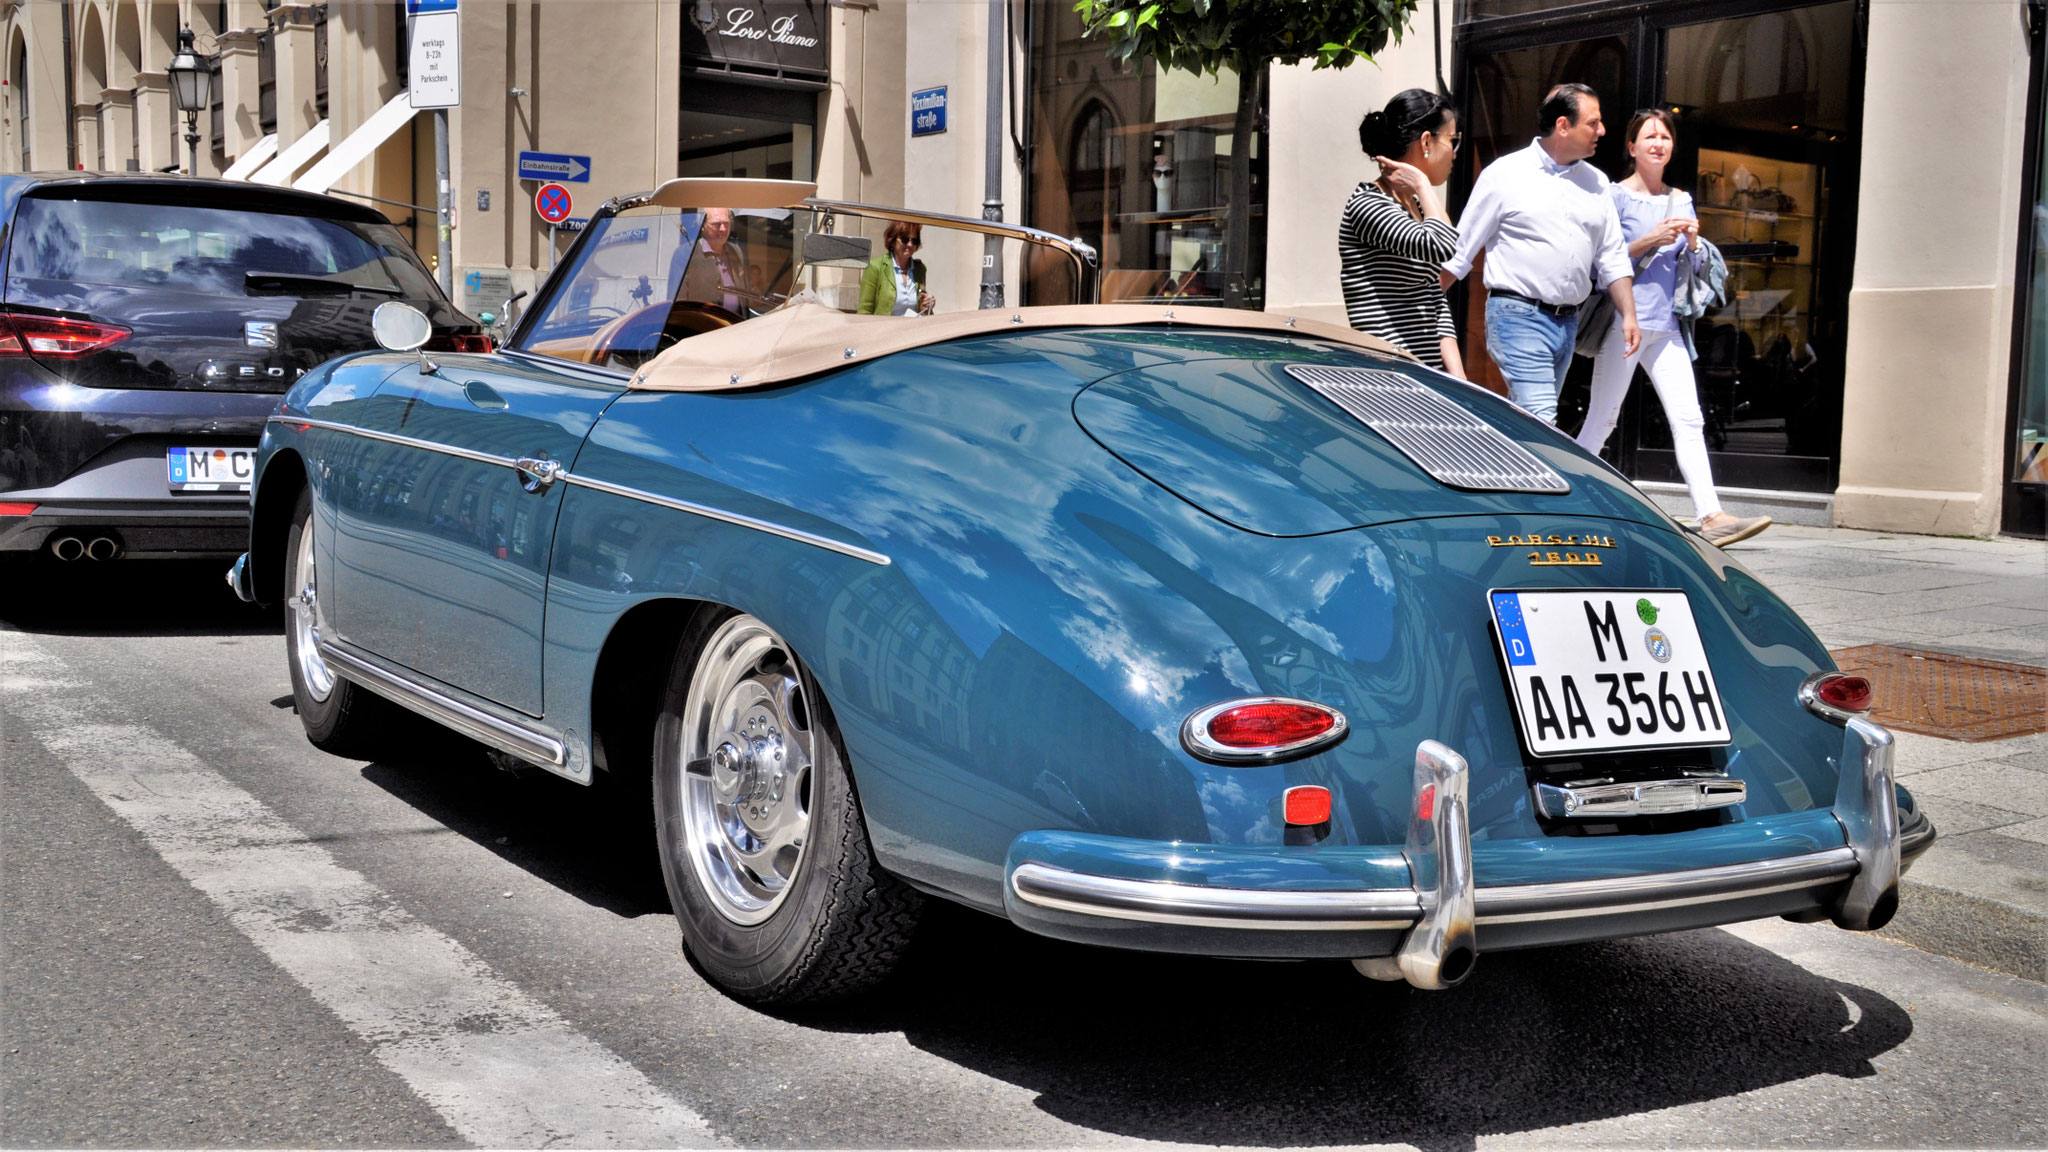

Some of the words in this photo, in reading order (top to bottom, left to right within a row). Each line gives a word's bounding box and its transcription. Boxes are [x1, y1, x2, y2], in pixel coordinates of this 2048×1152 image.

[719, 7, 767, 40] Loro
[768, 14, 818, 48] Piana
[422, 39, 445, 48] werktags
[429, 63, 438, 71] mit
[420, 74, 448, 83] Parkschein
[916, 111, 937, 130] straße
[522, 161, 570, 172] Einbahnstraße
[190, 451, 209, 478] M
[231, 451, 257, 478] C
[175, 467, 183, 477] D
[1486, 534, 1619, 548] PORSCHE
[1528, 552, 1603, 566] 1600
[1583, 600, 1628, 662] M
[1511, 638, 1525, 657] D
[1529, 674, 1596, 741] AA
[1594, 670, 1722, 736] 356H
